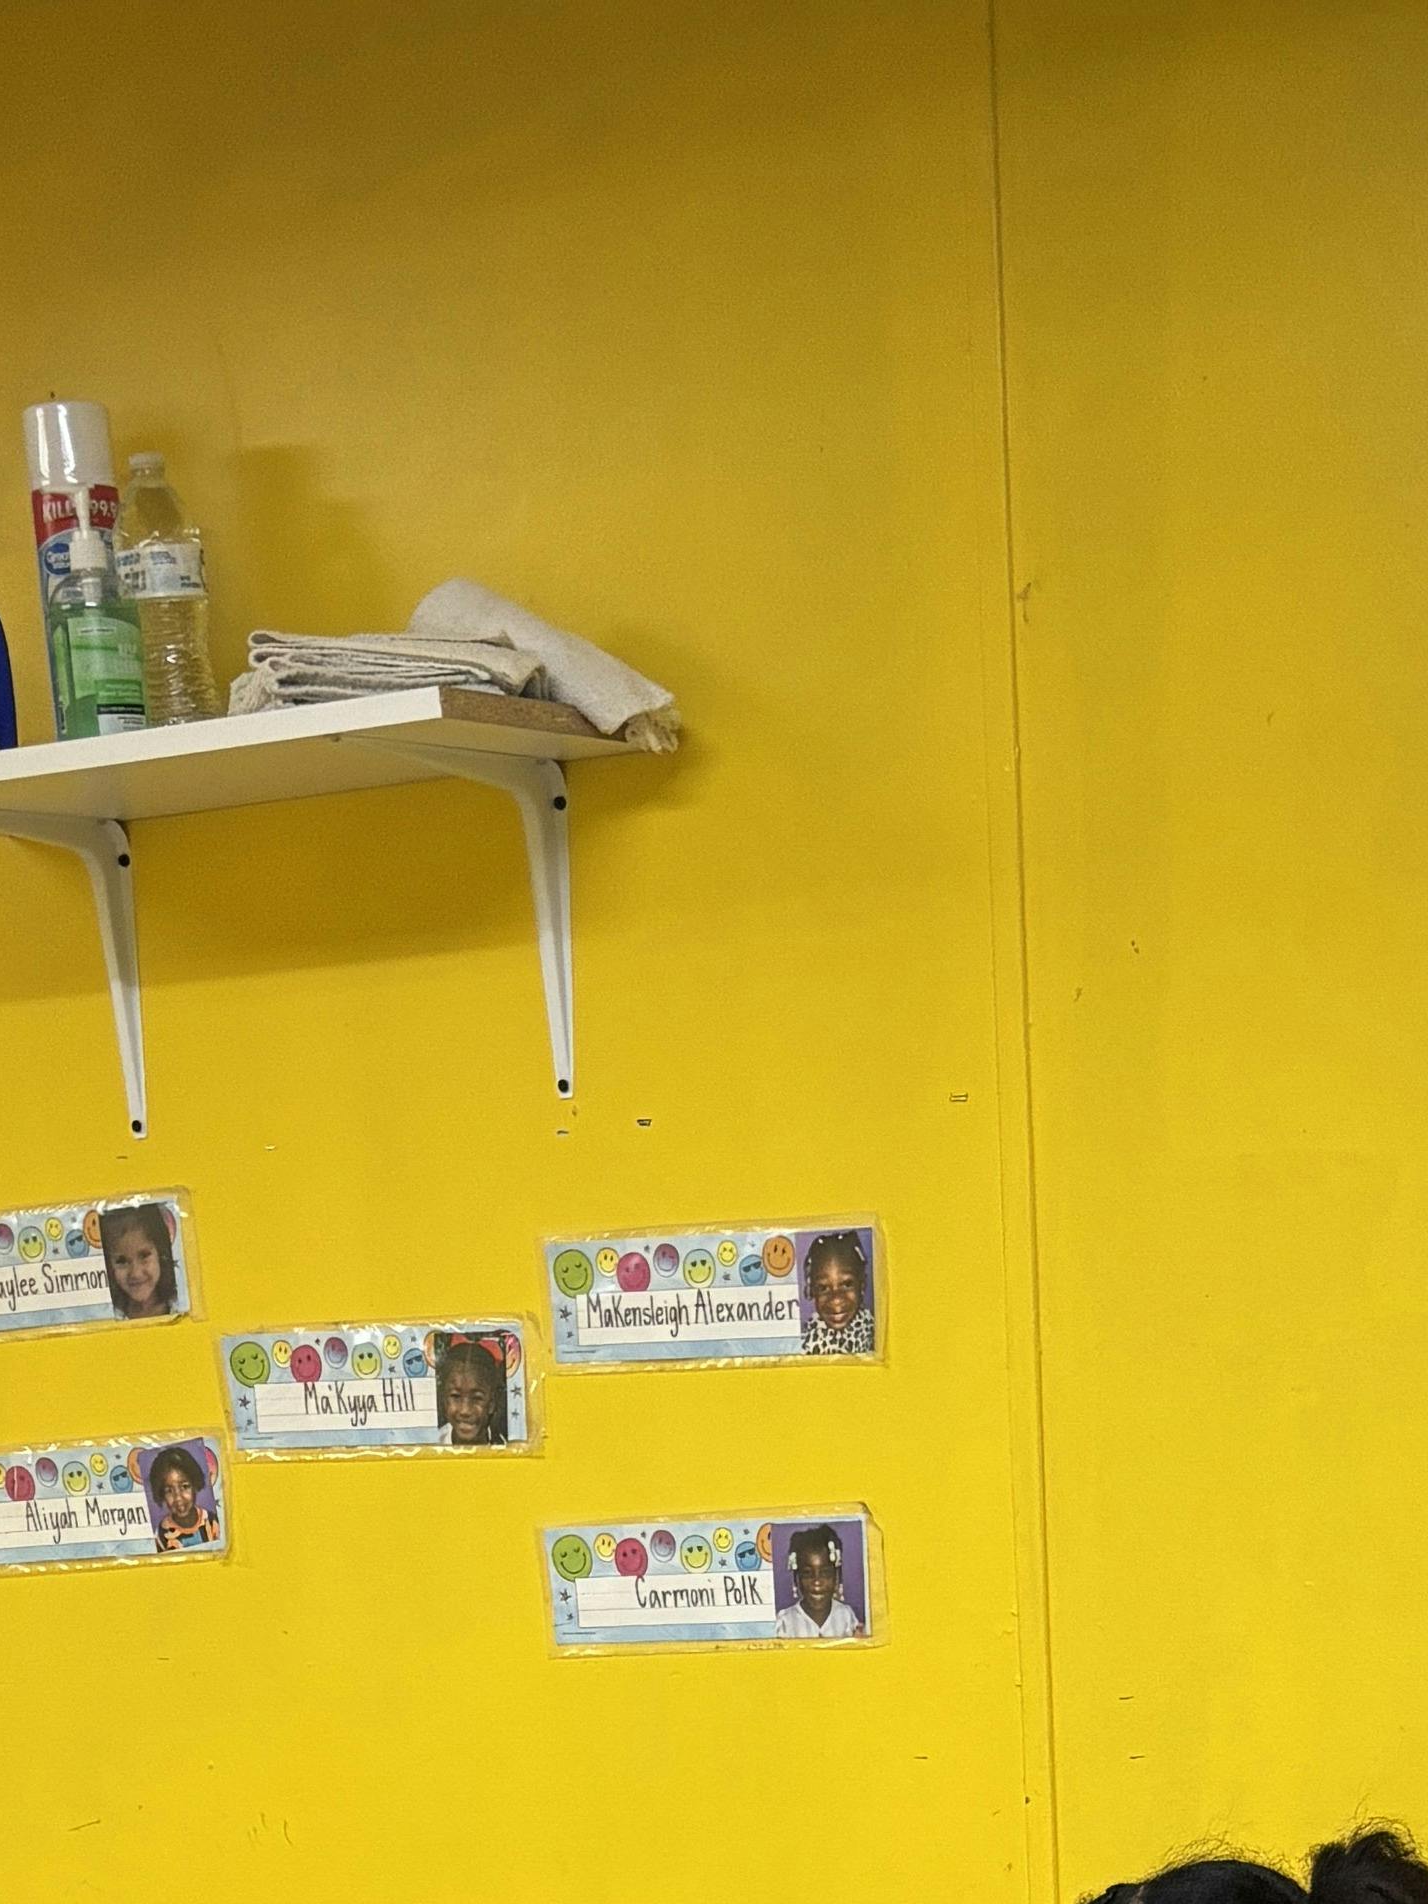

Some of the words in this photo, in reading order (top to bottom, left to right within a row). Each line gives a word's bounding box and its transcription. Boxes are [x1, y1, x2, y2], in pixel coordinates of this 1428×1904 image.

[42, 500, 76, 523] KILL
[694, 1288, 800, 1325] Alexander
[382, 1378, 415, 1412] Hill
[25, 1498, 79, 1544] Aliyah
[85, 1497, 148, 1535] Morgan
[635, 1575, 716, 1608] Carmoni
